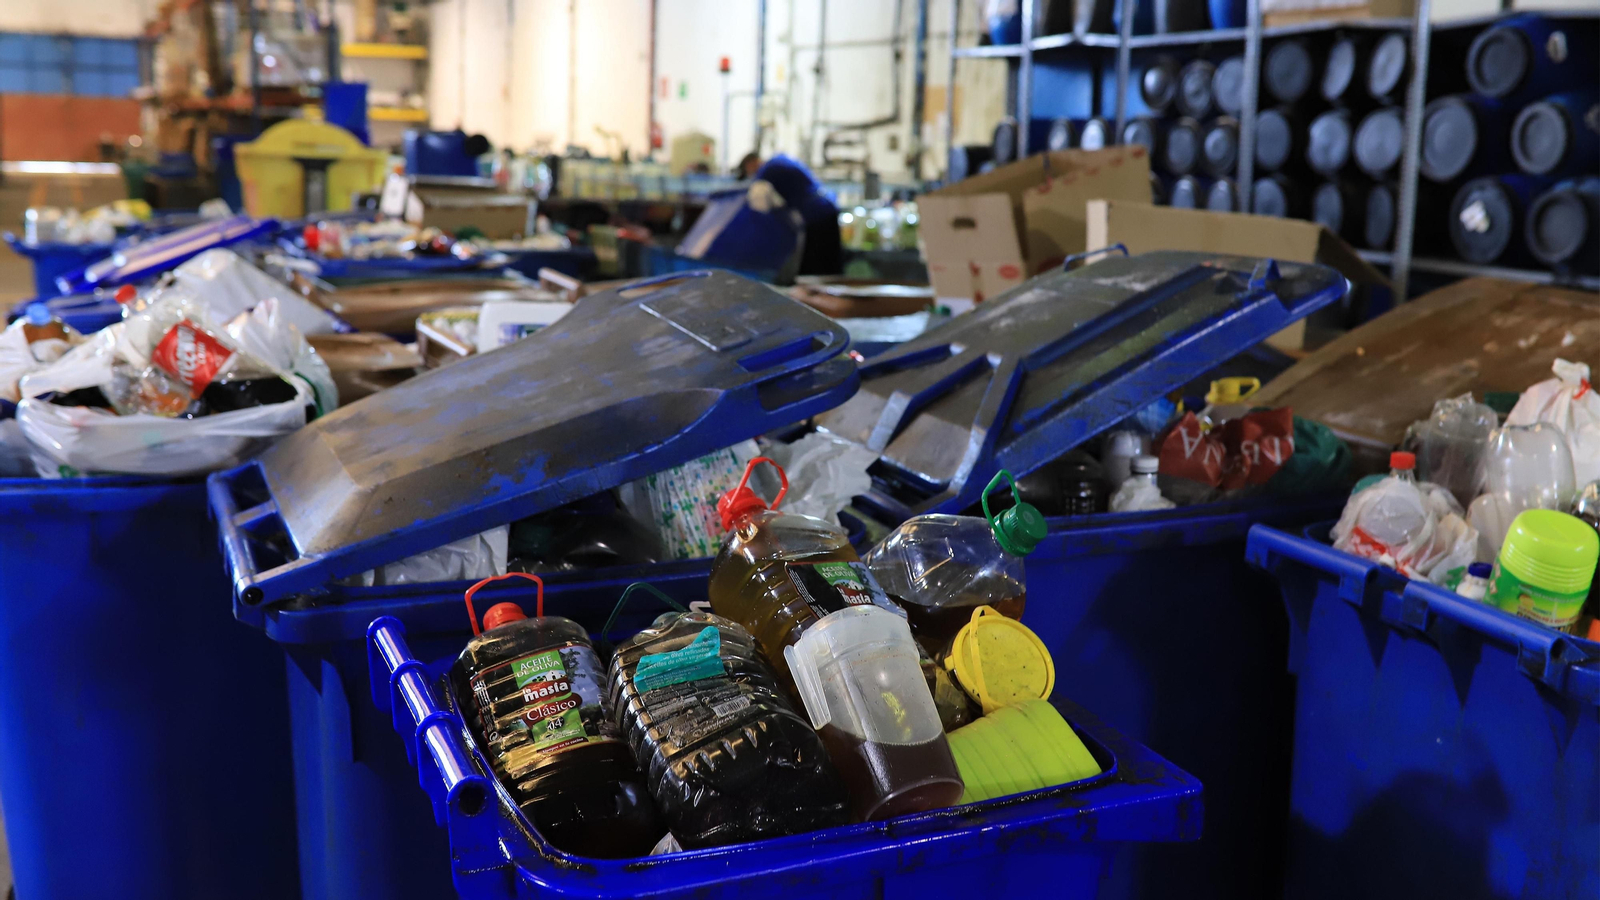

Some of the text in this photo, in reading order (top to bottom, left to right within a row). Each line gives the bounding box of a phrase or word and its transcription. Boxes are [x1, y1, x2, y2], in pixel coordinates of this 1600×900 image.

[516, 660, 560, 678] DE OLIVA
[520, 655, 552, 671] ACEITE
[526, 699, 577, 721] Clásico
